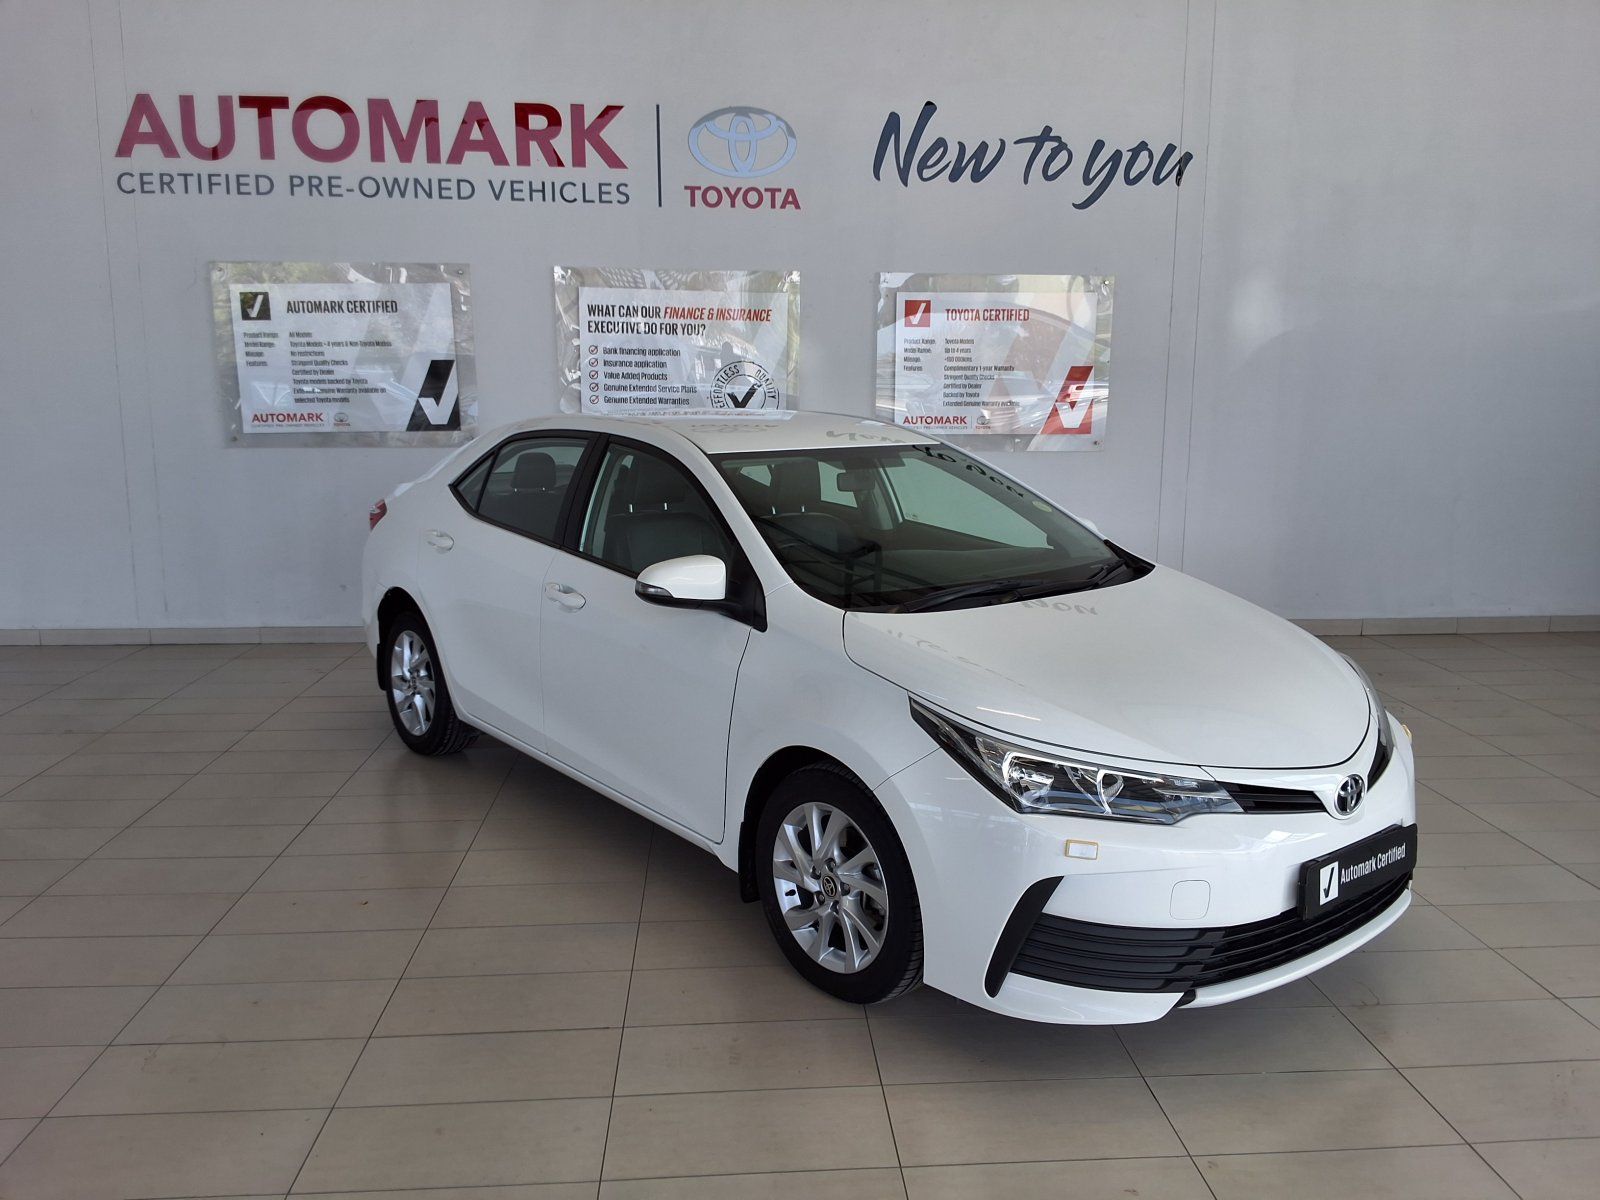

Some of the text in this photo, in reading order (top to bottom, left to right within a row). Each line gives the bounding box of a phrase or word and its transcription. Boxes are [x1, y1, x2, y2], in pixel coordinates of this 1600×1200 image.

[114, 93, 629, 170] AUTOMARK
[872, 100, 1194, 211] New to you
[116, 171, 630, 205] CERTIFIED PRE-OWNED VEHICLES
[684, 184, 802, 211] TOYOTA
[286, 300, 399, 314] AUTOMARK CERTIFIED
[587, 304, 773, 322] WHAT CAN OUR FINANCE & INSURANCE
[945, 308, 1030, 322] TOYOTA CERTIFIED
[587, 321, 707, 337] EXECUTIVE DO FOR YOU?
[603, 346, 681, 357] Bank financing application
[603, 359, 668, 369] Insurance application
[603, 371, 621, 379] Value
[640, 372, 668, 380] Products
[603, 383, 698, 394] Genuine Extended Service Plans
[712, 364, 740, 408] EFFORTLESS
[754, 369, 777, 400] QUALITY
[603, 395, 690, 405] Genuine Extended Warranties
[251, 412, 324, 423] AUTOMARK
[902, 415, 967, 425] AUTOMARK
[1340, 842, 1406, 885] Automark Certified
